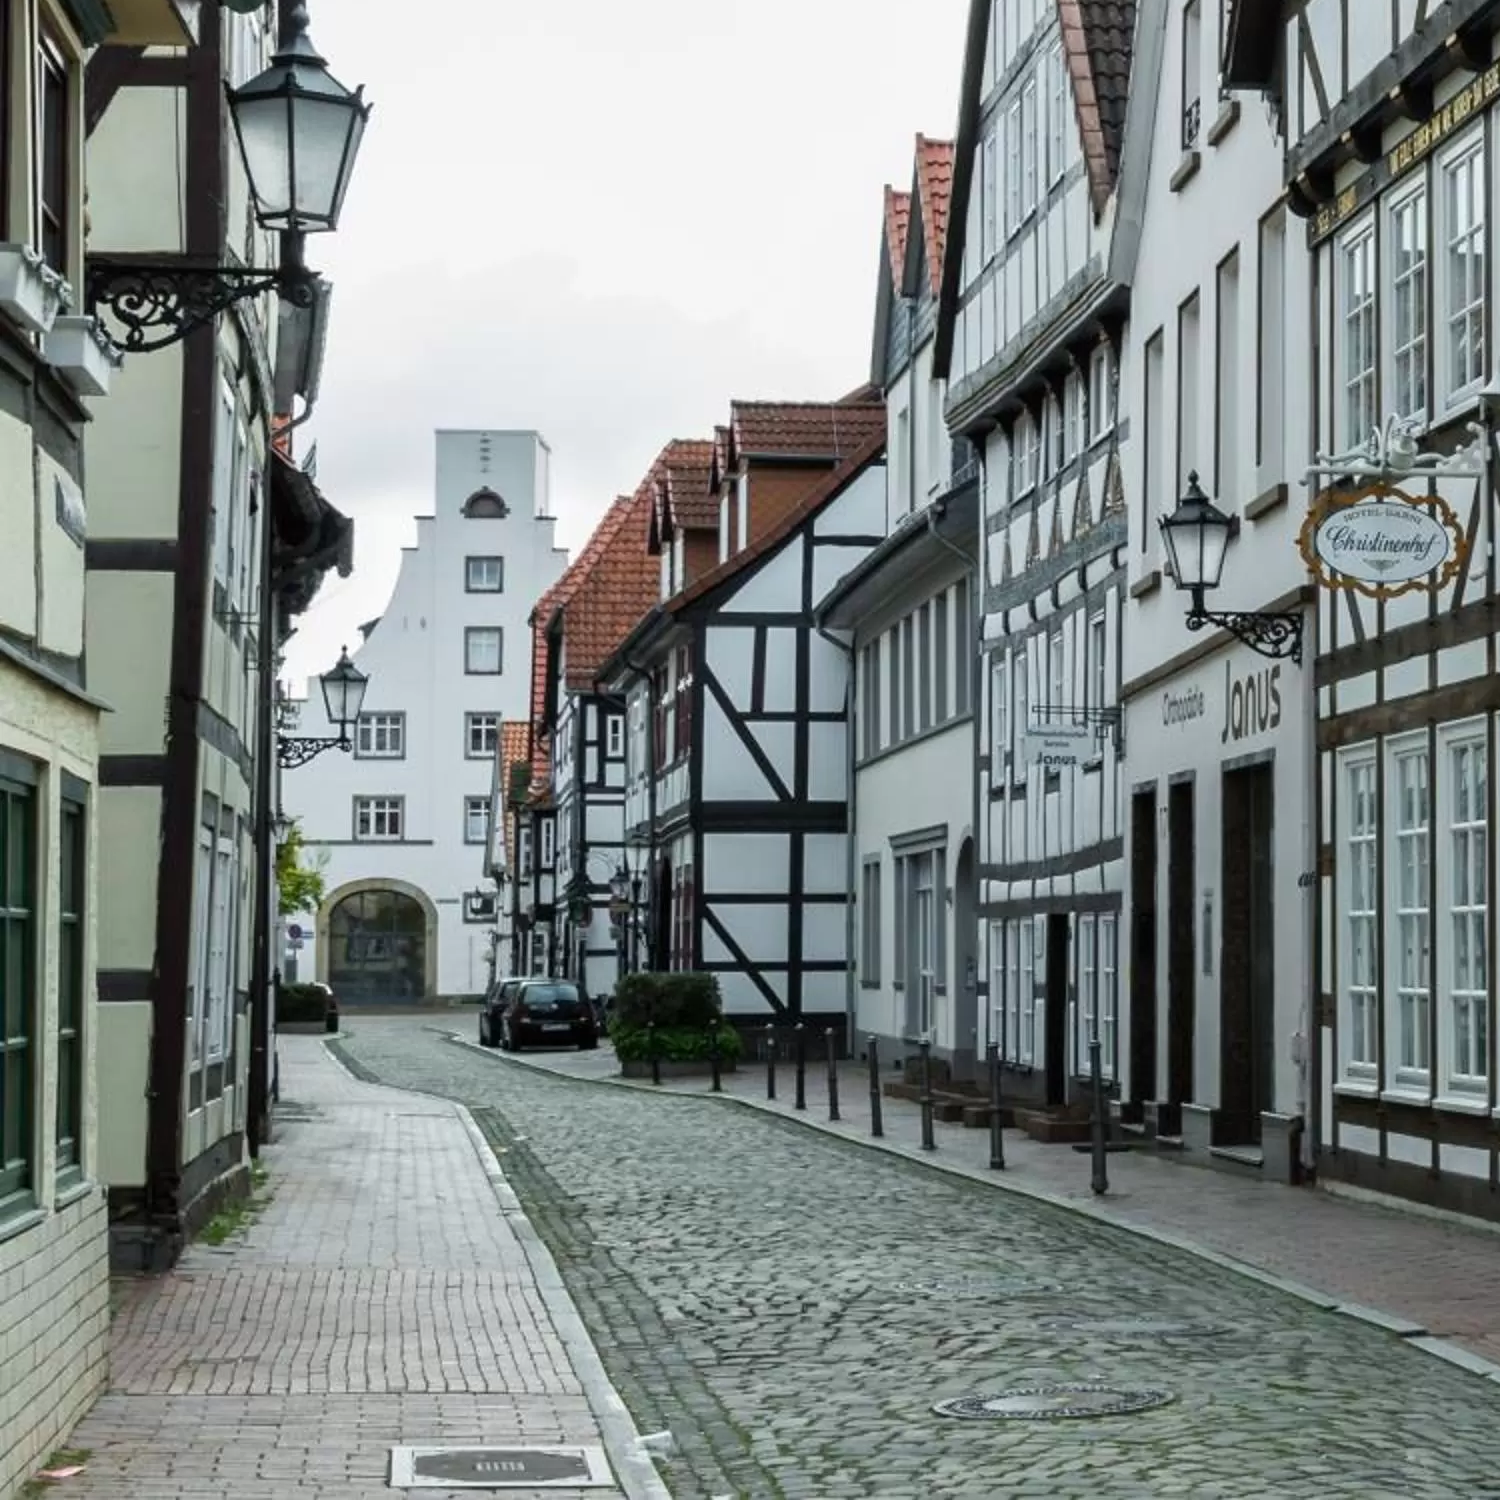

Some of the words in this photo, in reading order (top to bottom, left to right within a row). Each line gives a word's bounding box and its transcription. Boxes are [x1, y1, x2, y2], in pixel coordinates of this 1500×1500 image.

[1325, 525, 1441, 561] Christinenhof
[1221, 659, 1281, 745] Janus
[1035, 751, 1077, 765] Janus
